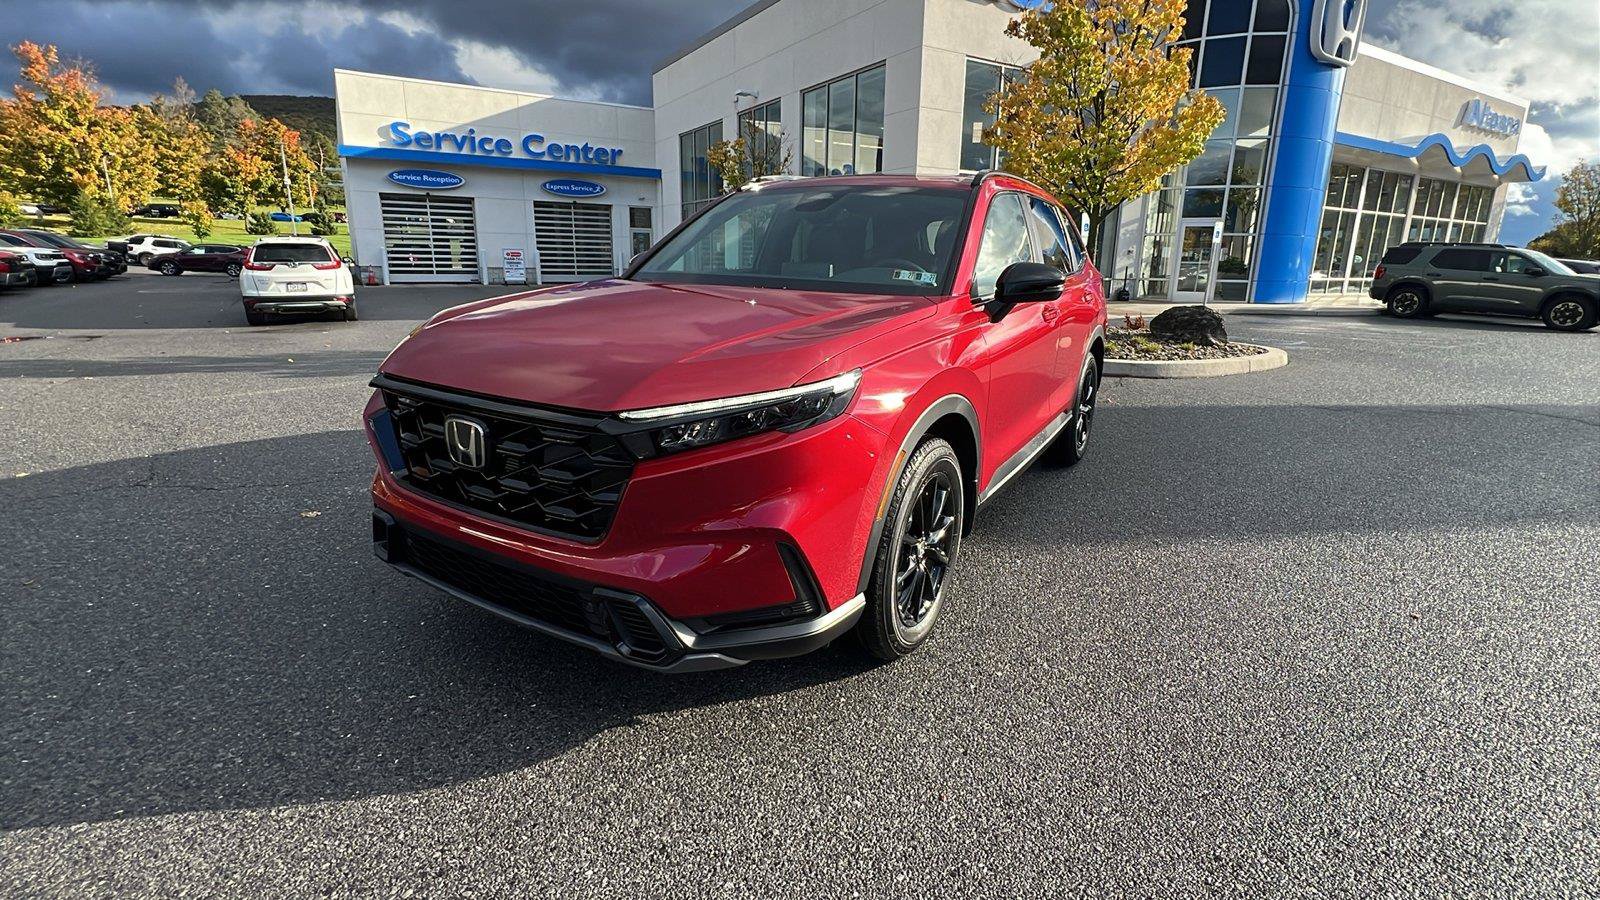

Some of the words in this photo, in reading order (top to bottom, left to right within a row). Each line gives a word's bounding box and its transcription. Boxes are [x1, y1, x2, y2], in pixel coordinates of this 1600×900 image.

[389, 121, 513, 155] Service
[521, 133, 624, 165] Center
[392, 172, 422, 181] Service
[422, 174, 460, 184] Reception
[545, 182, 570, 191] Express
[570, 184, 593, 192] Service
